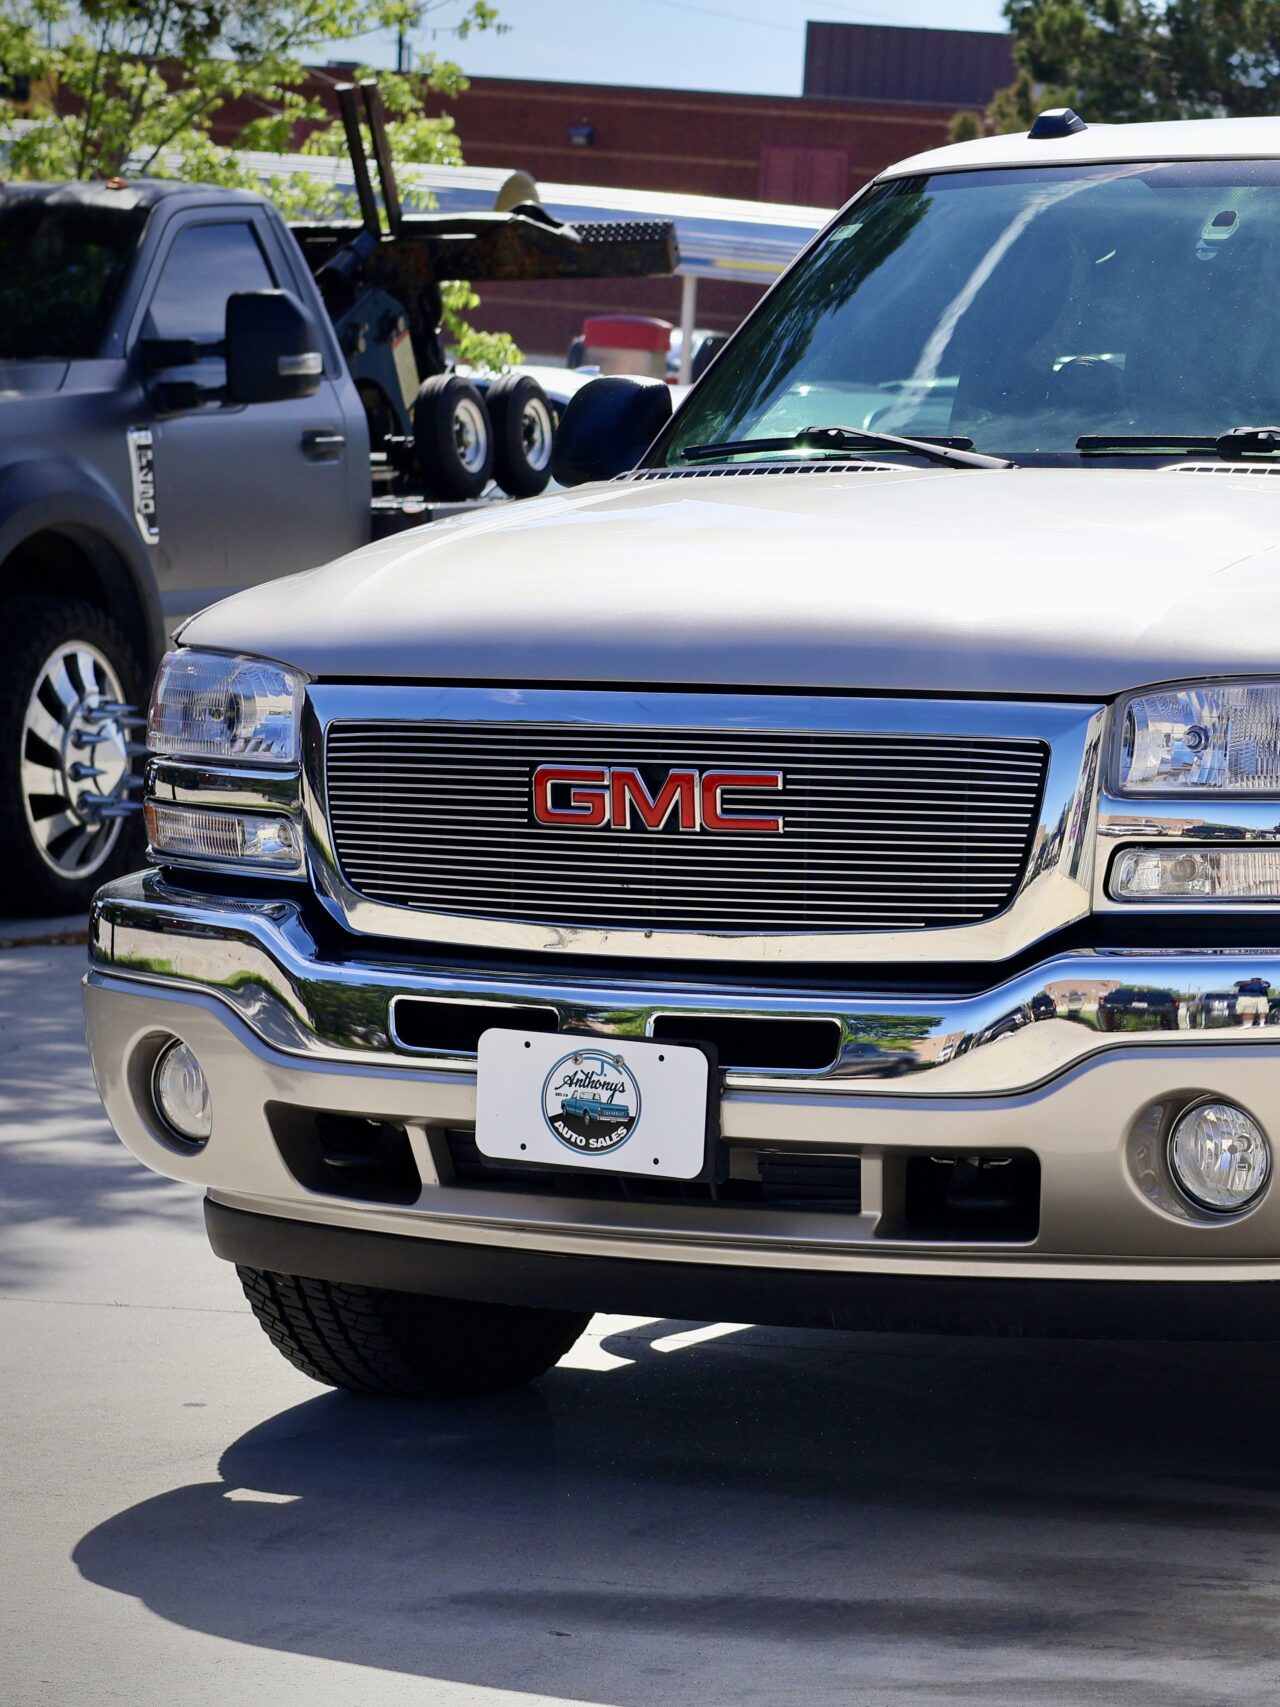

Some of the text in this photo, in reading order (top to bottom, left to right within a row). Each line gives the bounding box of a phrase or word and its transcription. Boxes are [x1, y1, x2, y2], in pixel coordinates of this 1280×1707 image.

[532, 764, 783, 833] GMC
[554, 1069, 627, 1104] Anthony's
[554, 1121, 628, 1148] AUTO SALES
